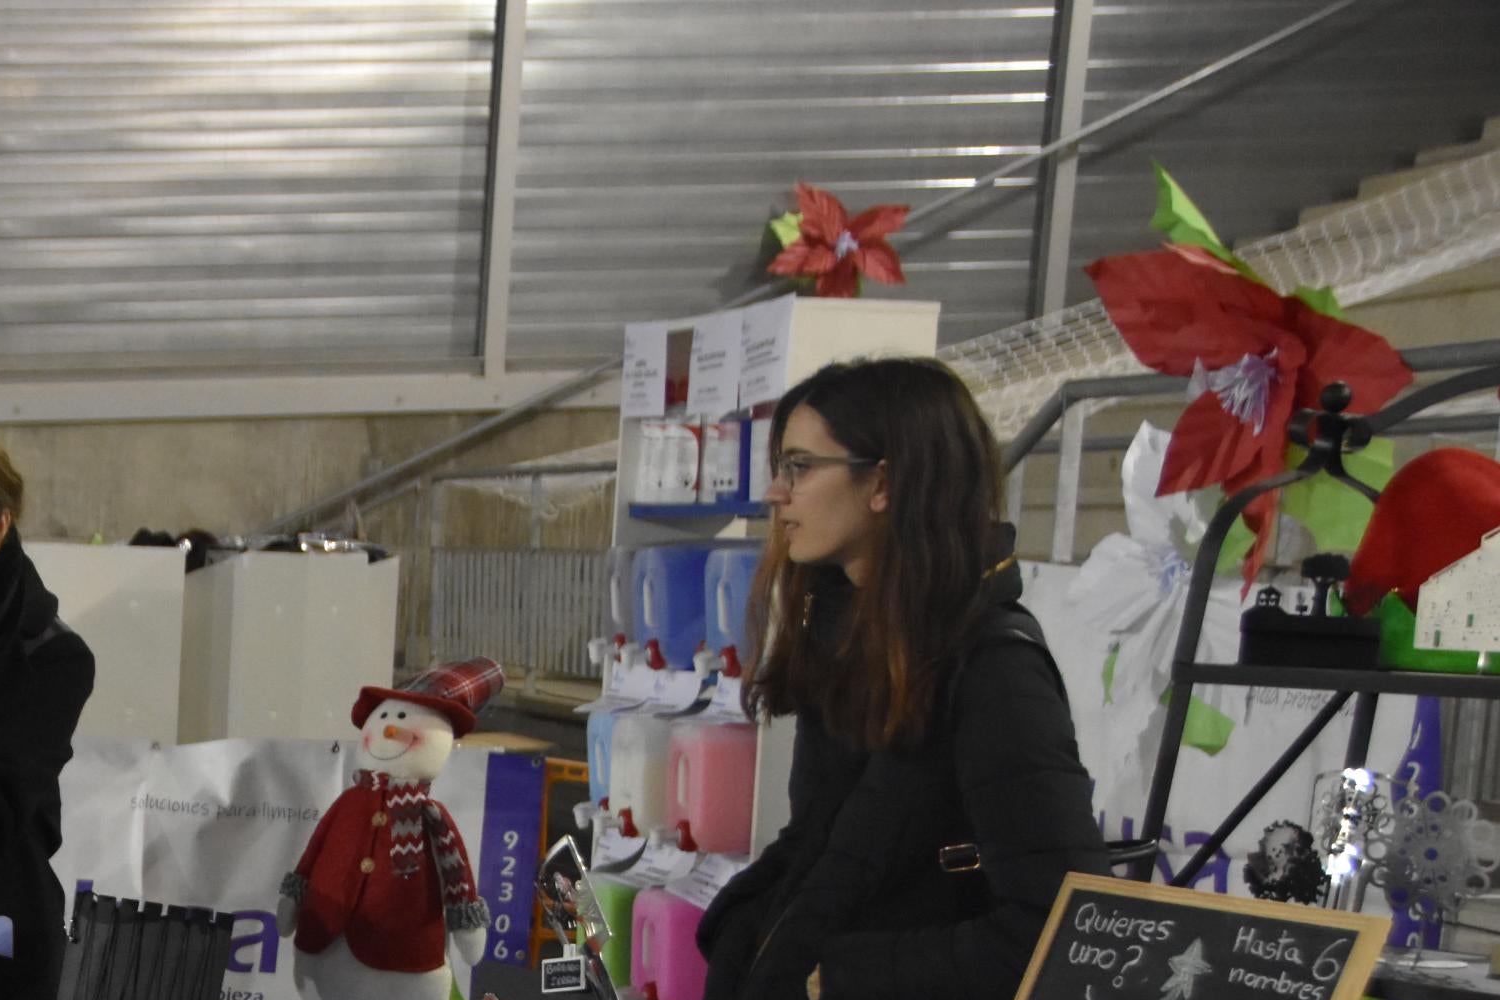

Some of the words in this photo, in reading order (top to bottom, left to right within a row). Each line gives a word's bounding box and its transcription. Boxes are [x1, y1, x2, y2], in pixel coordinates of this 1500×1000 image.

[130, 794, 209, 817] soluciones
[217, 803, 257, 819] para
[1074, 902, 1176, 942] Quieres
[1232, 926, 1303, 965] Hasta
[1312, 938, 1348, 982] 6
